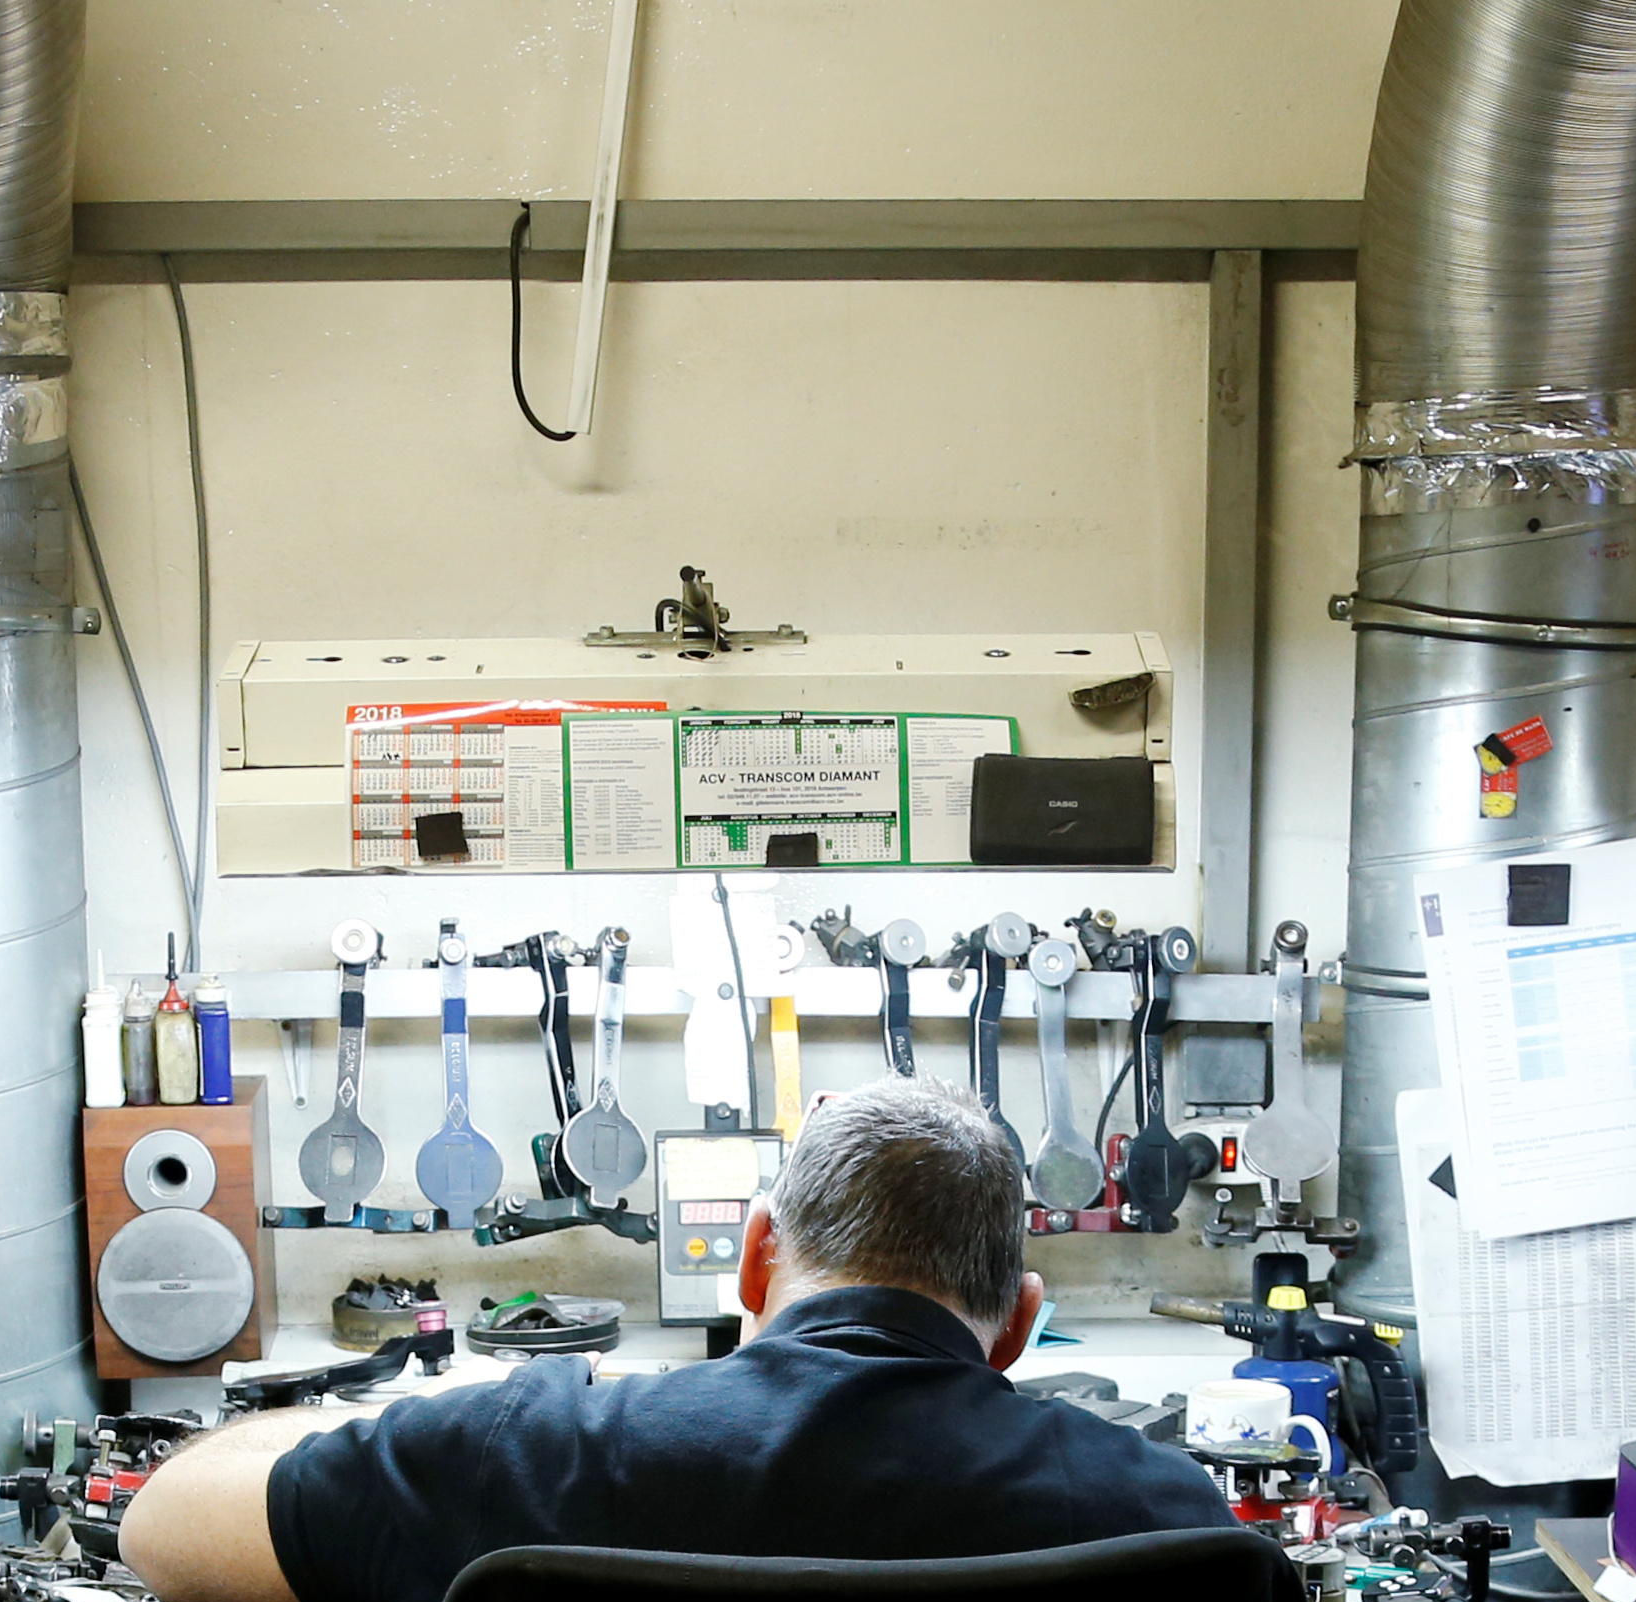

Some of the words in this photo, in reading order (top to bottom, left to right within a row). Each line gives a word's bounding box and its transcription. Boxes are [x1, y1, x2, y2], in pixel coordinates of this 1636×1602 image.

[353, 706, 403, 722] 2018
[699, 773, 726, 784] ACV
[739, 772, 815, 784] TRANSCOM
[819, 770, 881, 782] DIAMANT
[1048, 800, 1078, 808] CASIO
